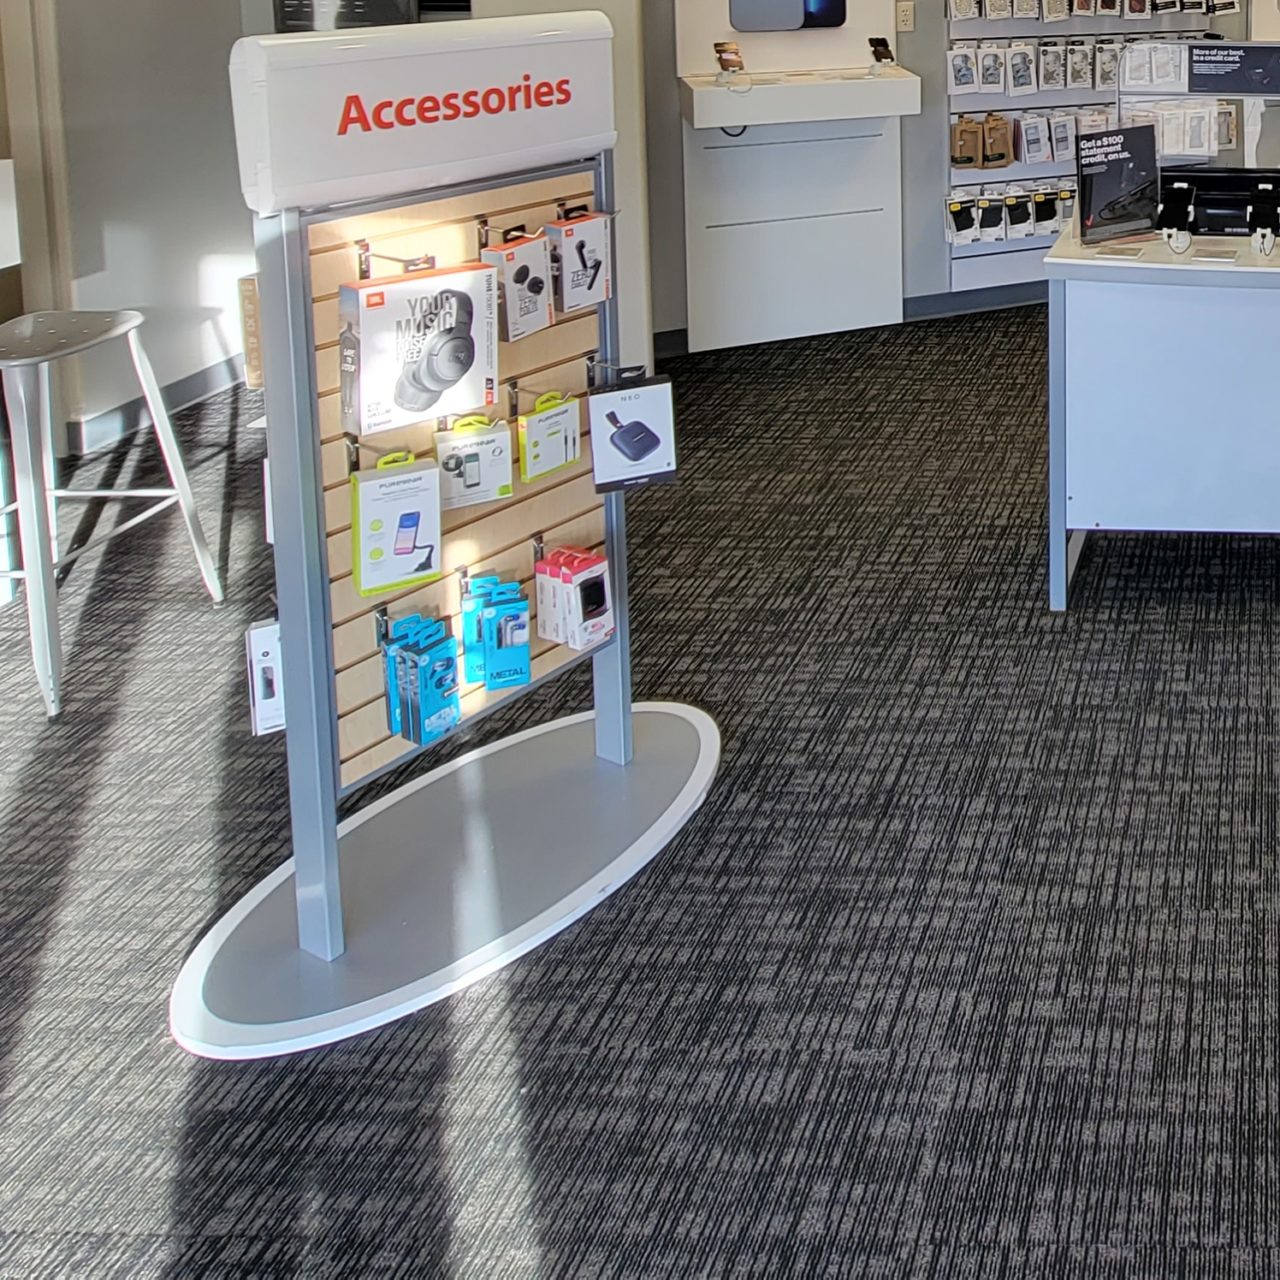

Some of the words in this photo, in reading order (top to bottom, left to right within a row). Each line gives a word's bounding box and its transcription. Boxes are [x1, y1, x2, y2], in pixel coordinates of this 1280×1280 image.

[337, 74, 572, 136] Accessories
[1080, 139, 1096, 148] Get
[1102, 135, 1124, 146] $100
[1081, 144, 1122, 156] statement
[1081, 154, 1108, 164] credit,
[406, 293, 452, 317] YOUR
[396, 312, 453, 339] MUSIC
[621, 394, 640, 402] NEO
[490, 667, 526, 680] METAL
